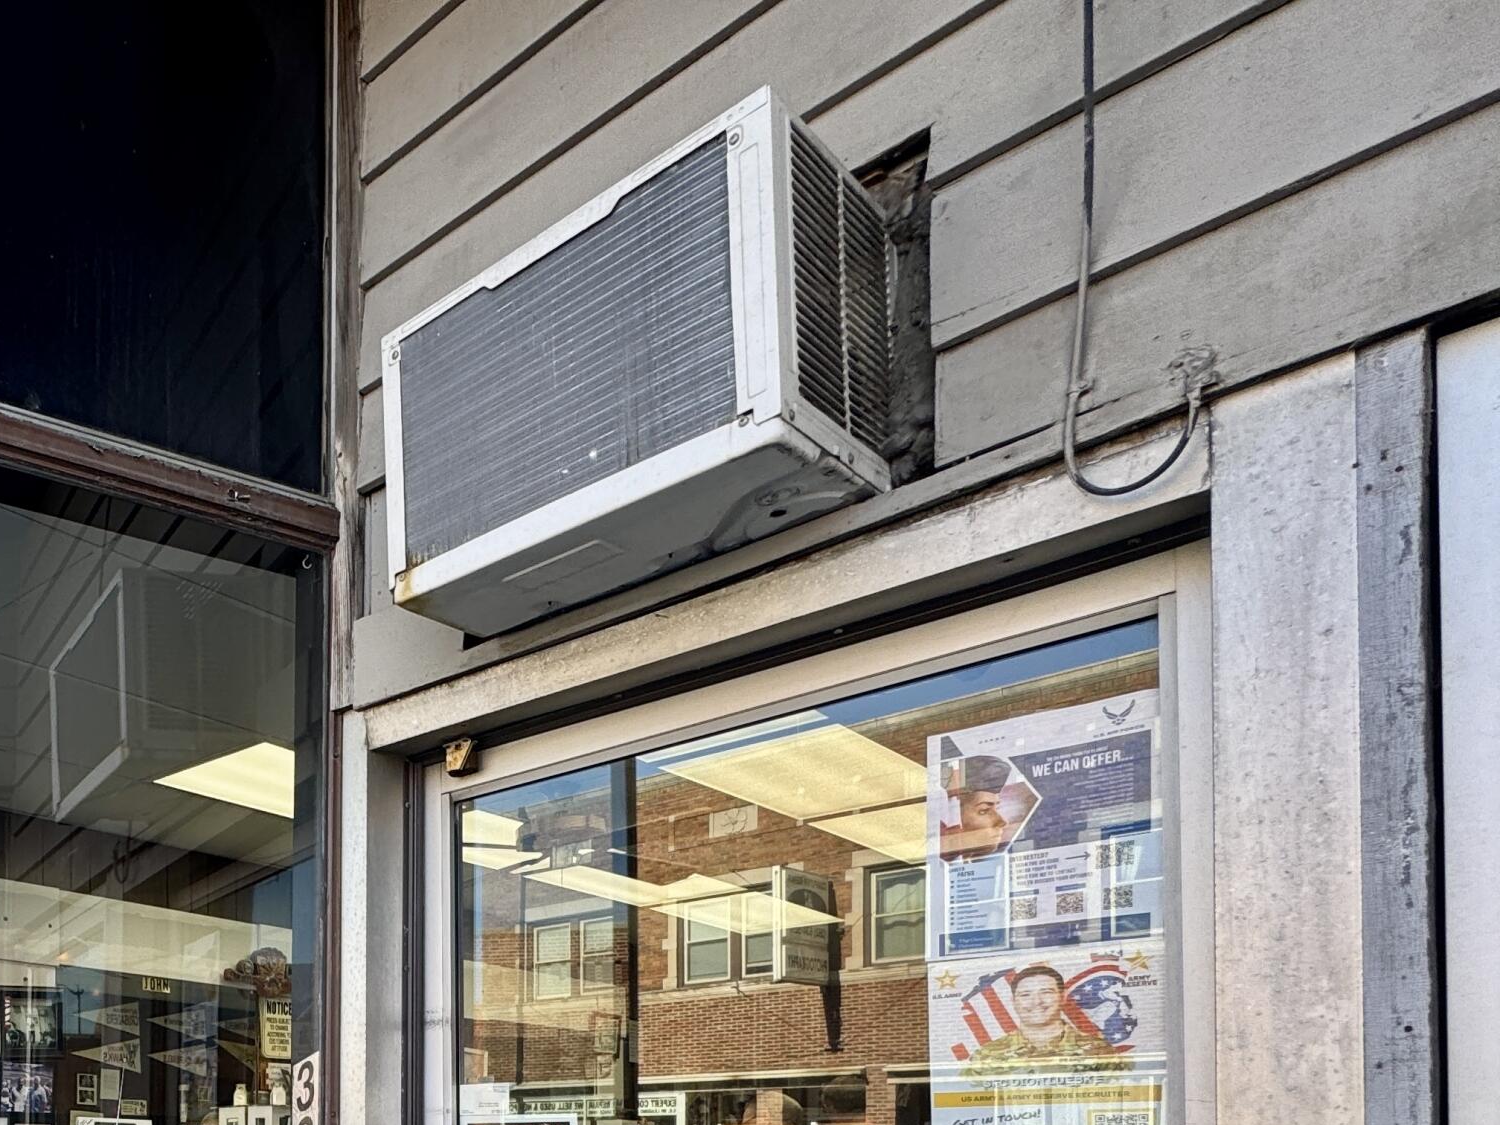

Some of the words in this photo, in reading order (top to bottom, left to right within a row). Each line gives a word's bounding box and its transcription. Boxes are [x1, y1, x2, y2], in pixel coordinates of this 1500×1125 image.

[1032, 763, 1051, 778] WE
[1054, 757, 1080, 774] CAN
[144, 977, 169, 991] JOHN
[1121, 979, 1157, 988] RESERVE
[1128, 974, 1151, 982] ARMY
[267, 1000, 292, 1016] NOTICE
[973, 1095, 996, 1103] ARMY
[1033, 1092, 1073, 1100] RESERVE
[1076, 1090, 1131, 1099] RECRUITER
[981, 1115, 994, 1124] IN
[997, 1109, 1041, 1123] TOUCH!
